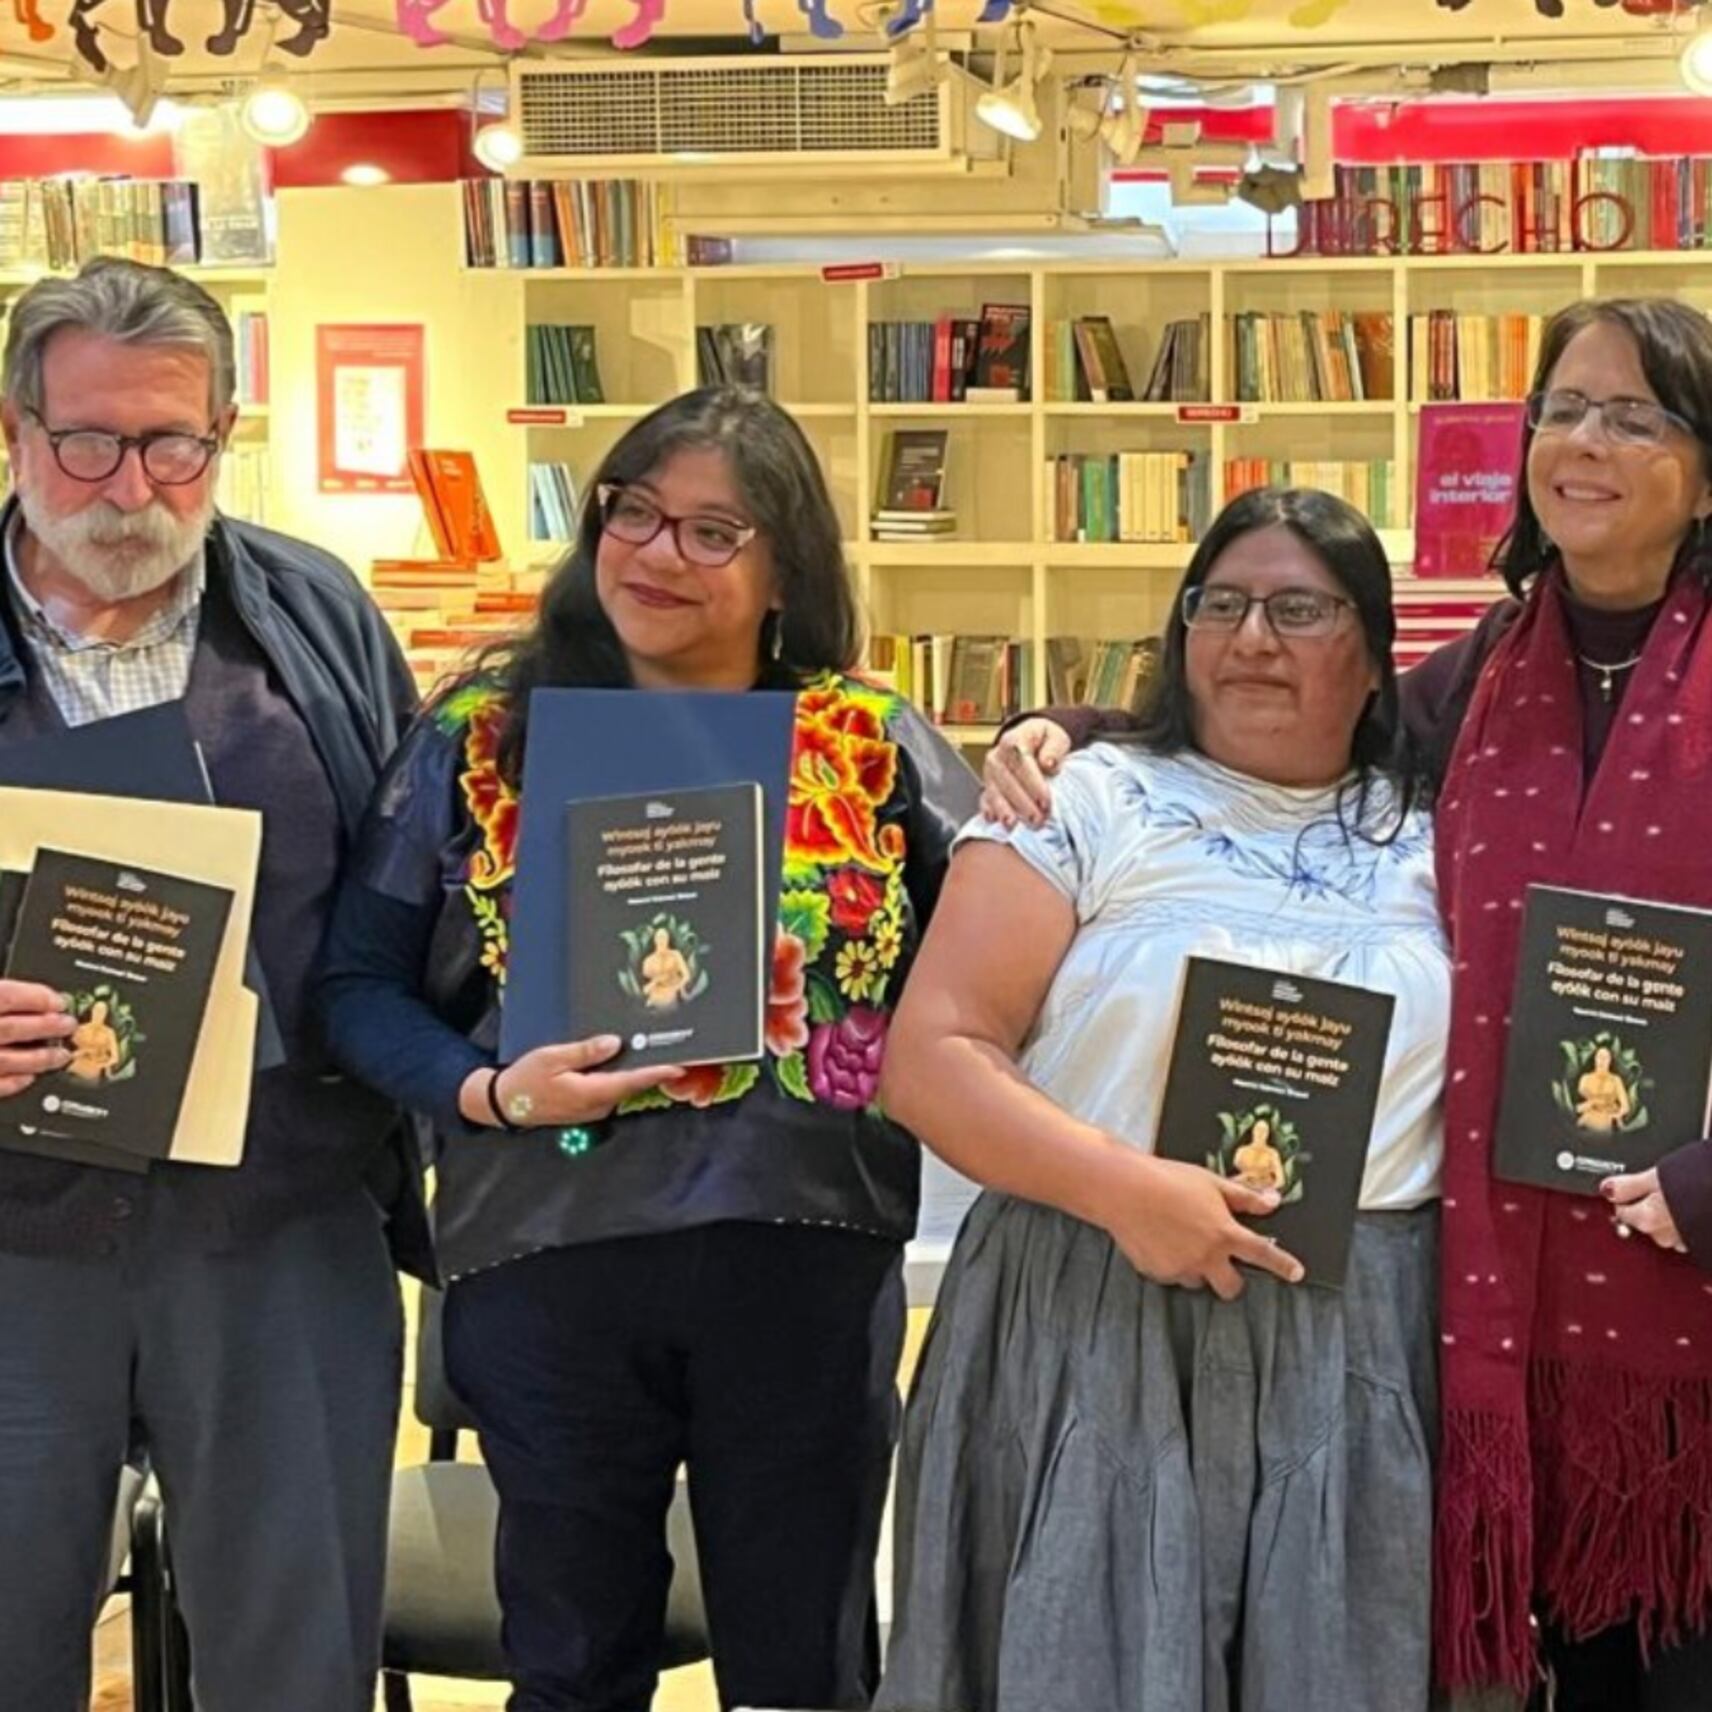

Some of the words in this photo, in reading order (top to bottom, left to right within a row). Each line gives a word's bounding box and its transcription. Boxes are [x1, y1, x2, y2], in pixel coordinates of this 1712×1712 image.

[1440, 471, 1459, 487] el
[1462, 471, 1512, 489] viaje
[1429, 489, 1512, 504] interior
[1606, 972, 1623, 986] de
[1626, 974, 1639, 988] la
[1641, 979, 1683, 997] gente
[1593, 988, 1619, 1002] con
[1622, 993, 1639, 1005] su
[1206, 1032, 1267, 1055] Filosofar
[1269, 1045, 1287, 1059] de
[1290, 1048, 1304, 1062] la
[1305, 1054, 1348, 1071] gente
[1255, 1061, 1282, 1075] con
[1284, 1066, 1302, 1079] su
